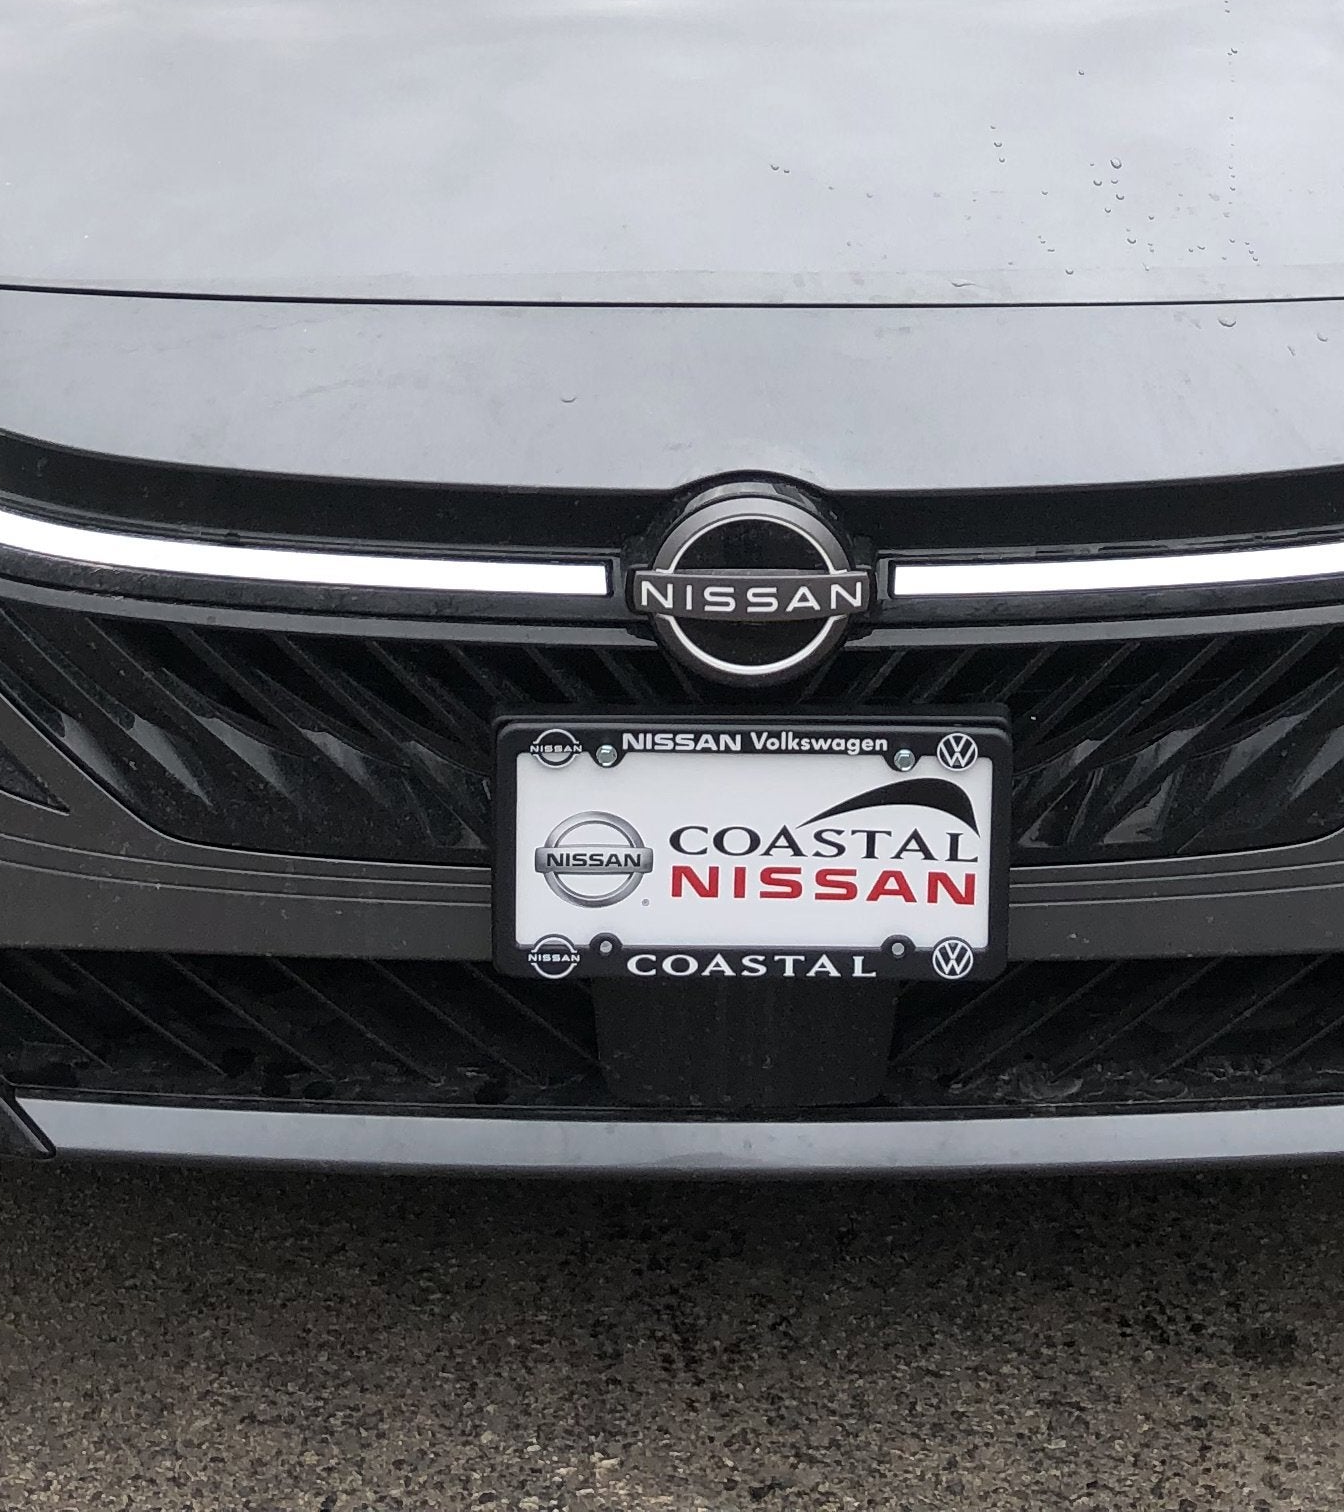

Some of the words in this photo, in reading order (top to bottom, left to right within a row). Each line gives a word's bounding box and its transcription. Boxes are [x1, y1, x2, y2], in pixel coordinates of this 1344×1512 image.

[641, 580, 862, 613] NISSAN
[530, 744, 583, 753] NISSAN
[622, 733, 742, 751] NISSAN
[750, 731, 888, 756] Volkswagen
[669, 825, 979, 863] COASTAL
[546, 853, 641, 868] NISSAN
[670, 865, 976, 906] NISSAN
[528, 953, 581, 963] NISSAN
[626, 953, 877, 977] COASTAL
